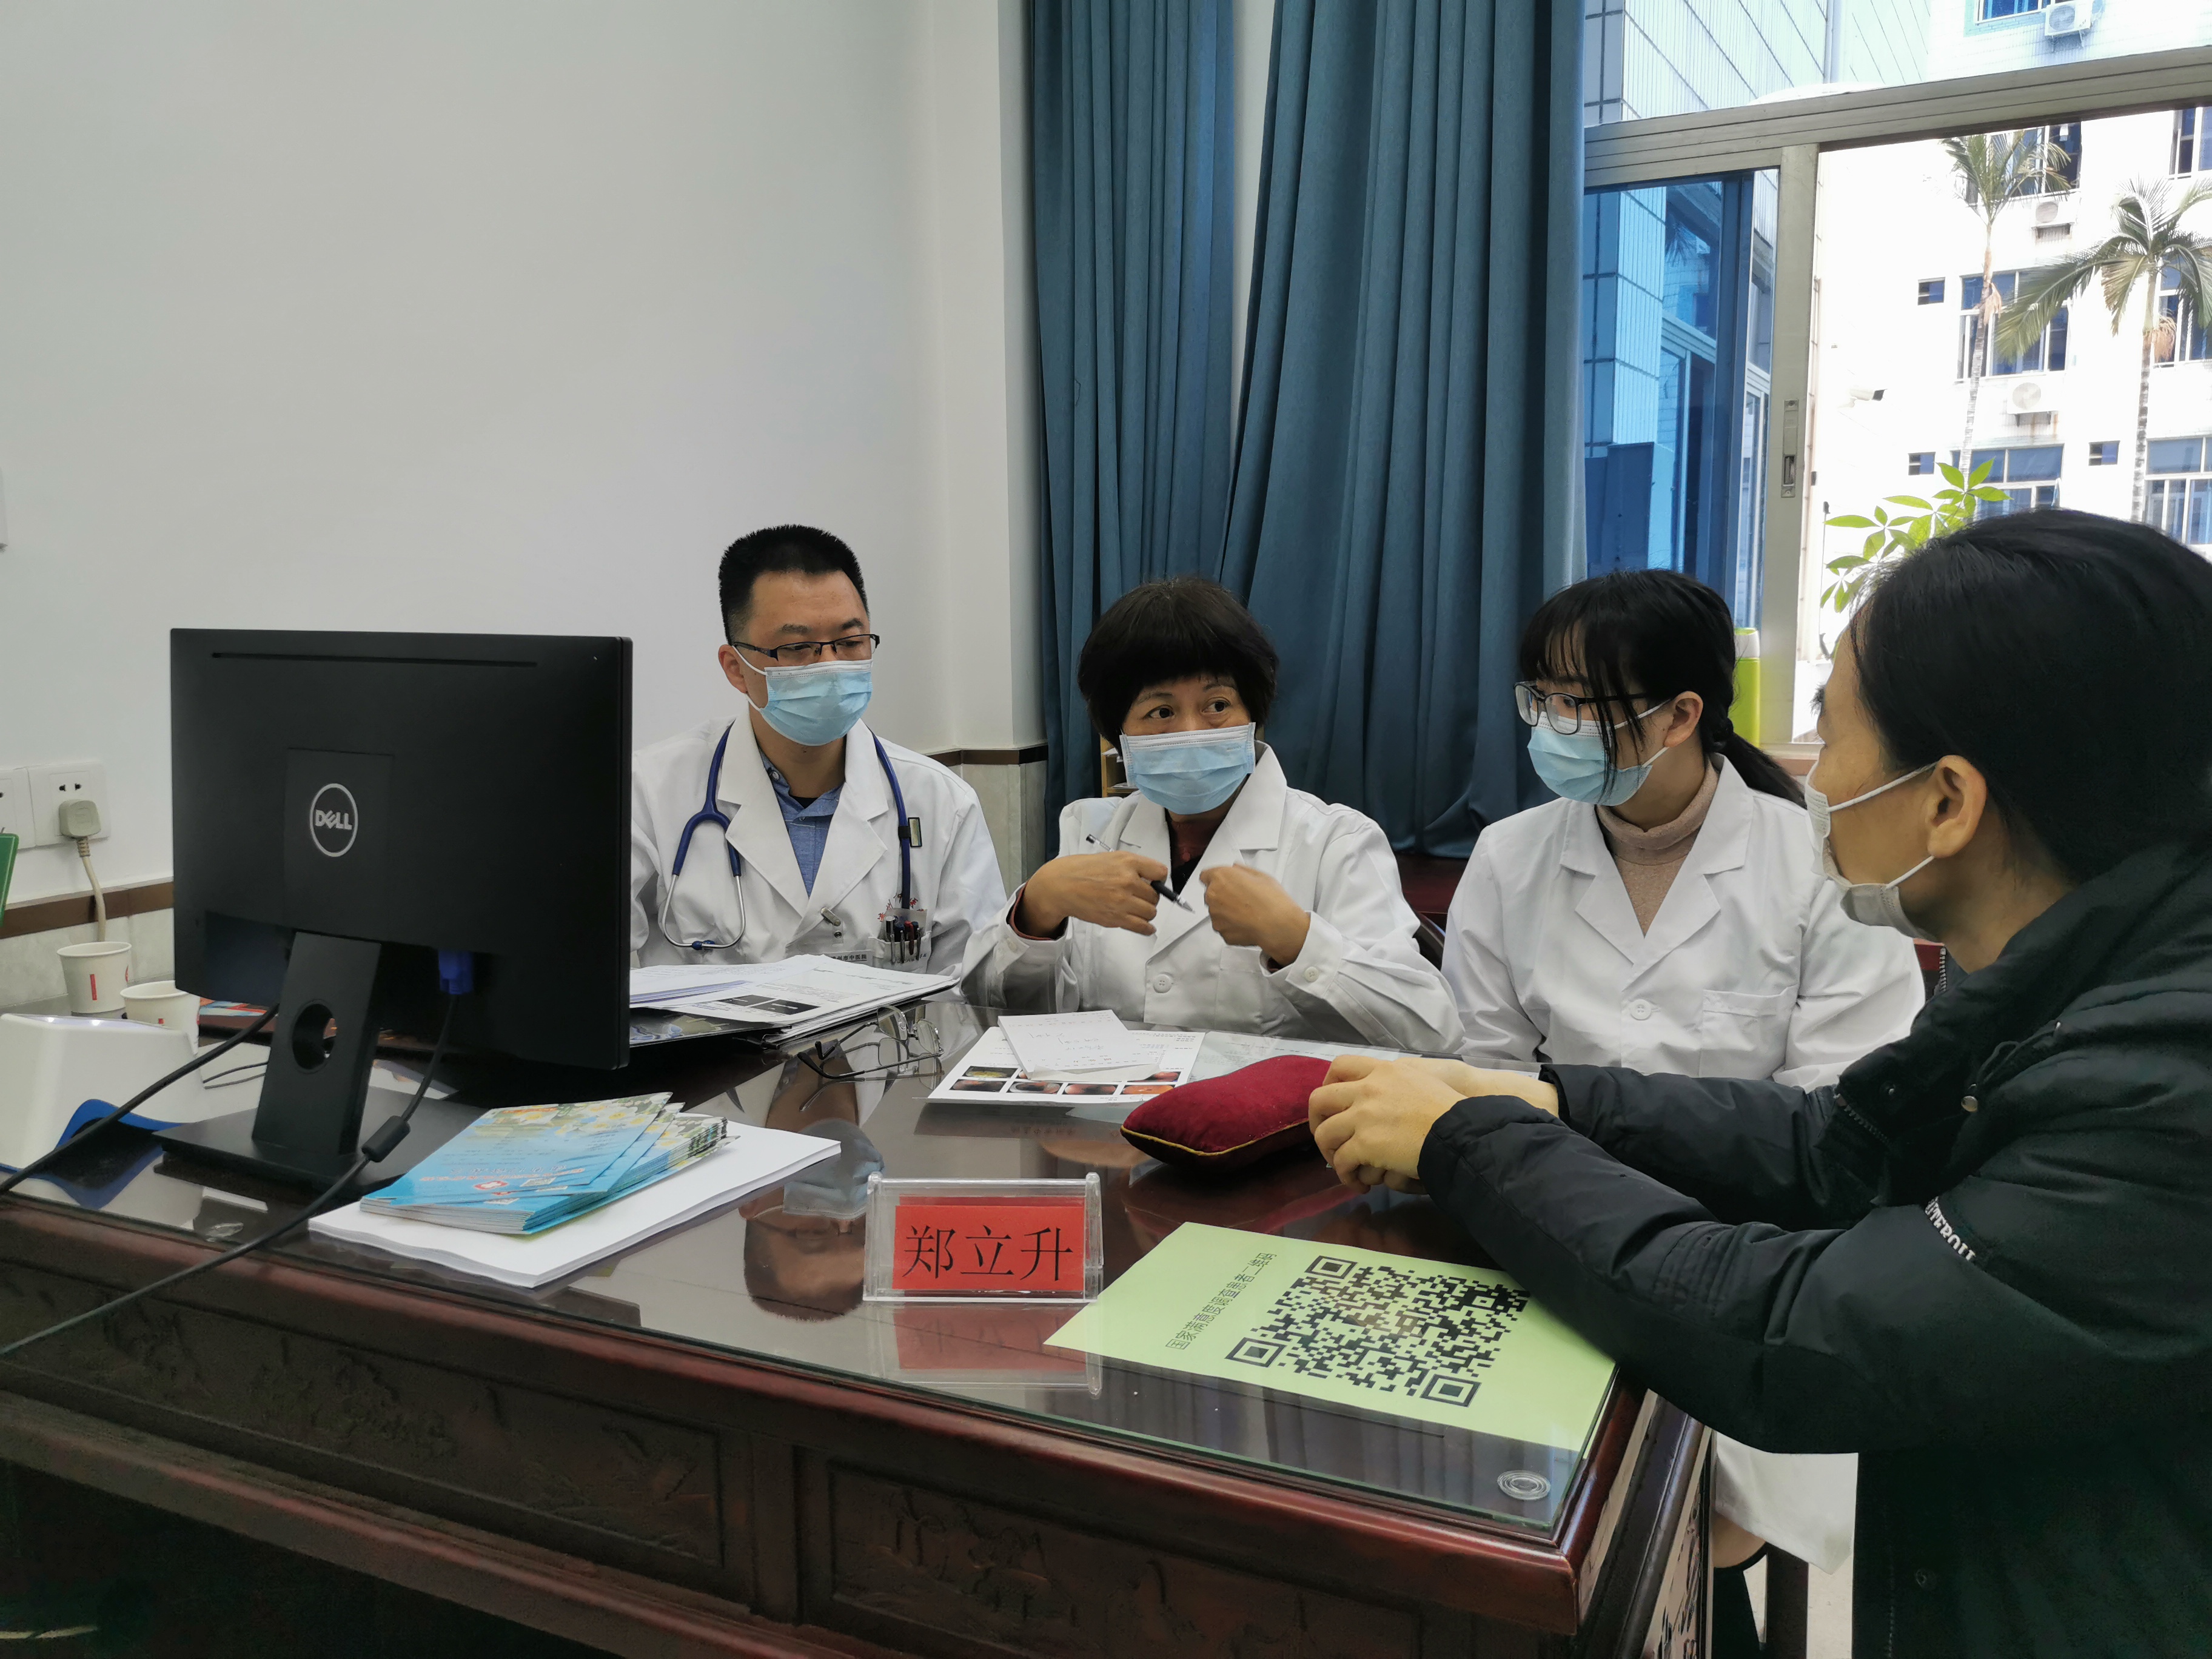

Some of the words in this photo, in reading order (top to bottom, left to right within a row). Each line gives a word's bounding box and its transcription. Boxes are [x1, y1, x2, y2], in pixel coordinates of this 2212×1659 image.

[315, 809, 352, 830] DELL
[902, 1224, 1074, 1282] 郑立升
[1165, 1253, 1278, 1350] 国家满意度调查患者二维码
